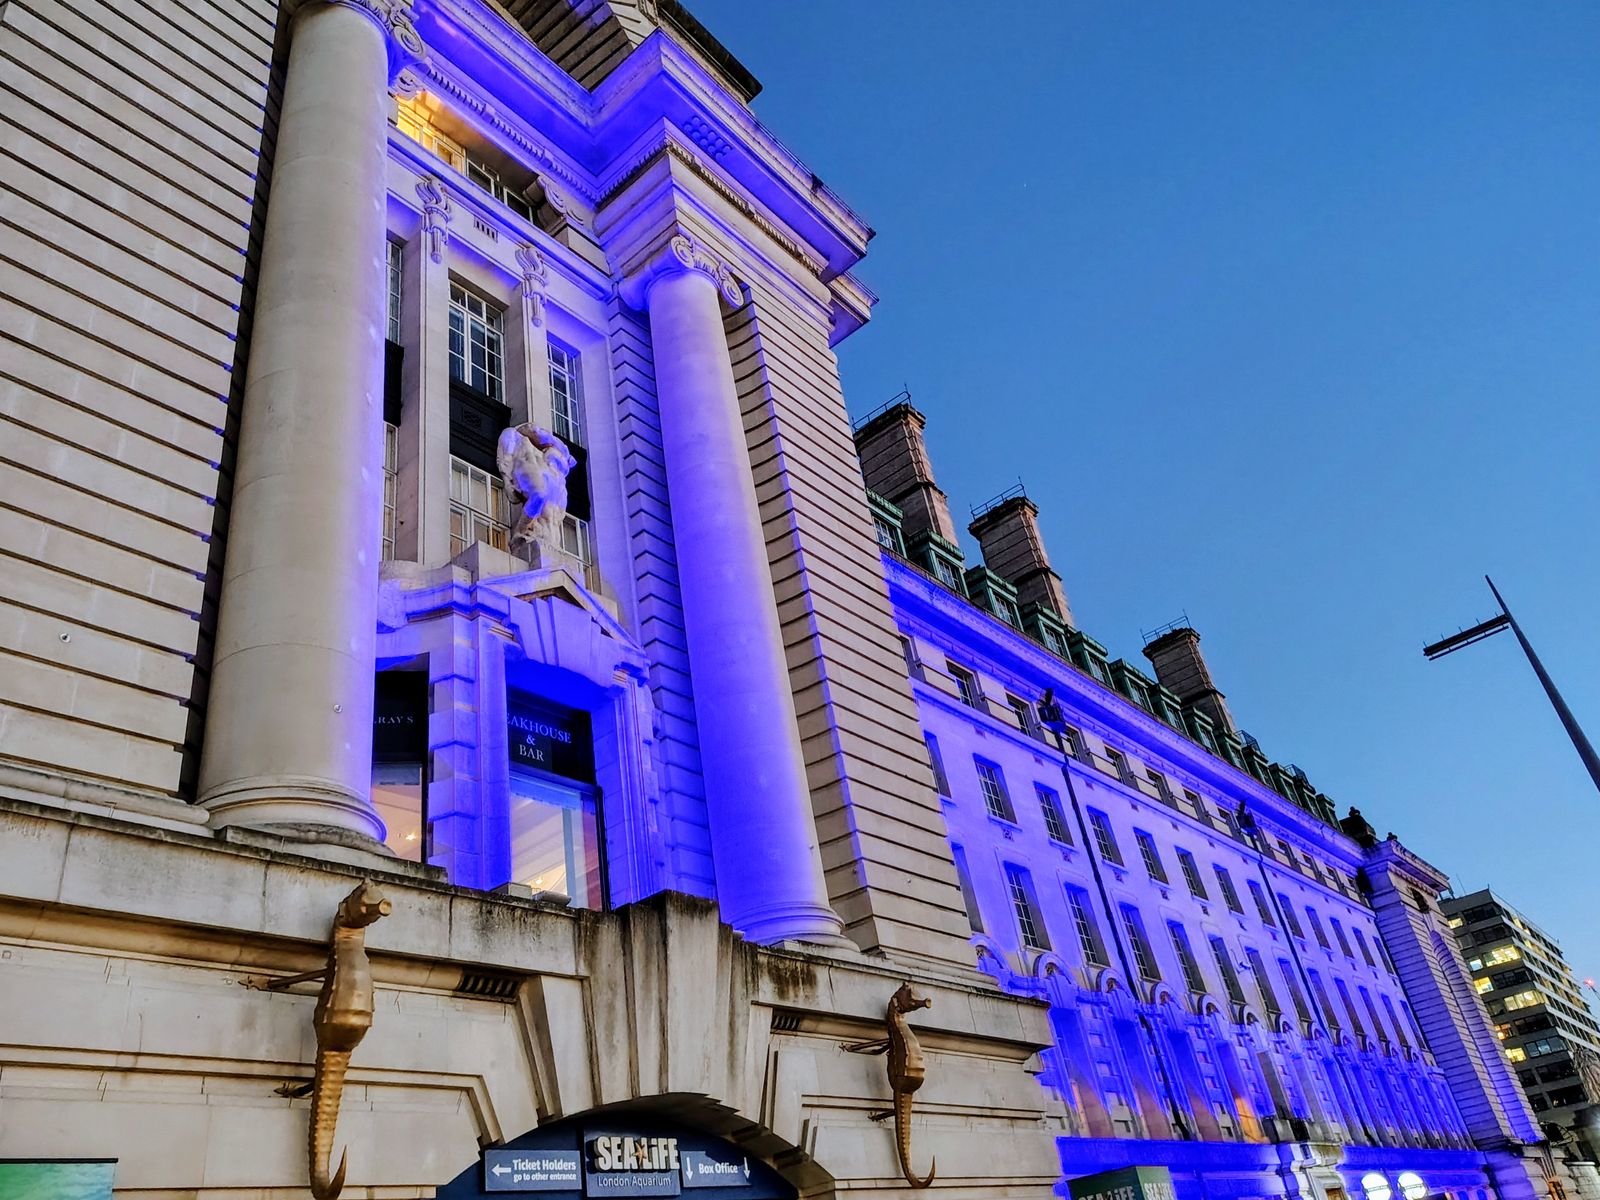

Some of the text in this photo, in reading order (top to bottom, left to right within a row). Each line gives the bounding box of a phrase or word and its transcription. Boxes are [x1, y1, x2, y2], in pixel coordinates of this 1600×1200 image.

[374, 715, 414, 724] RAY'S
[526, 734, 536, 746] &
[519, 744, 545, 762] BAR
[597, 1136, 637, 1170] SEA
[512, 1158, 577, 1171] Ticket Holders
[699, 1162, 738, 1174] Box Office
[513, 1172, 577, 1183] go to other entrance
[598, 1175, 671, 1189] London Aquarium
